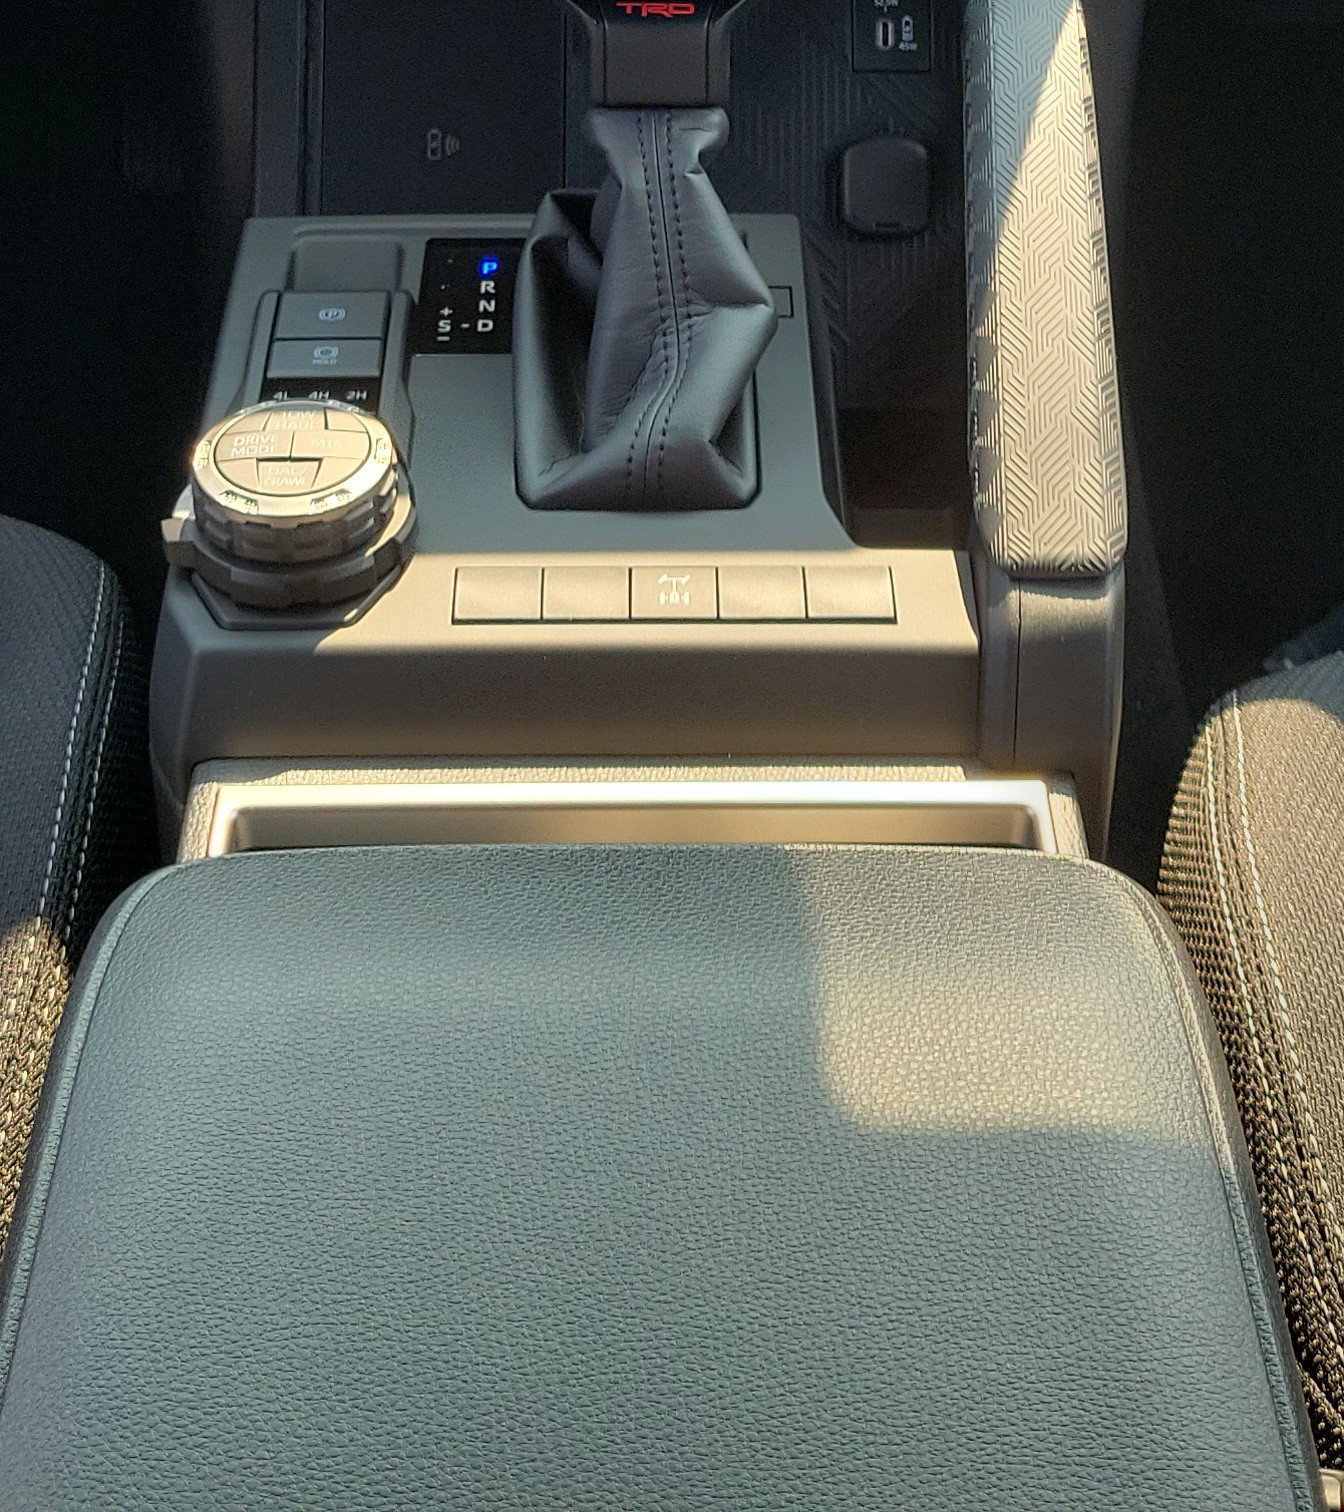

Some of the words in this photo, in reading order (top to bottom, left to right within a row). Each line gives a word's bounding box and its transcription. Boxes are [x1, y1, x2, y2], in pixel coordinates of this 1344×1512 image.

[615, 2, 695, 18] TRD
[482, 261, 498, 275] P
[480, 280, 496, 294] R
[479, 299, 496, 313] N
[437, 319, 452, 333] S
[477, 319, 494, 333] D
[309, 390, 330, 400] 4H
[345, 390, 368, 400] 2H
